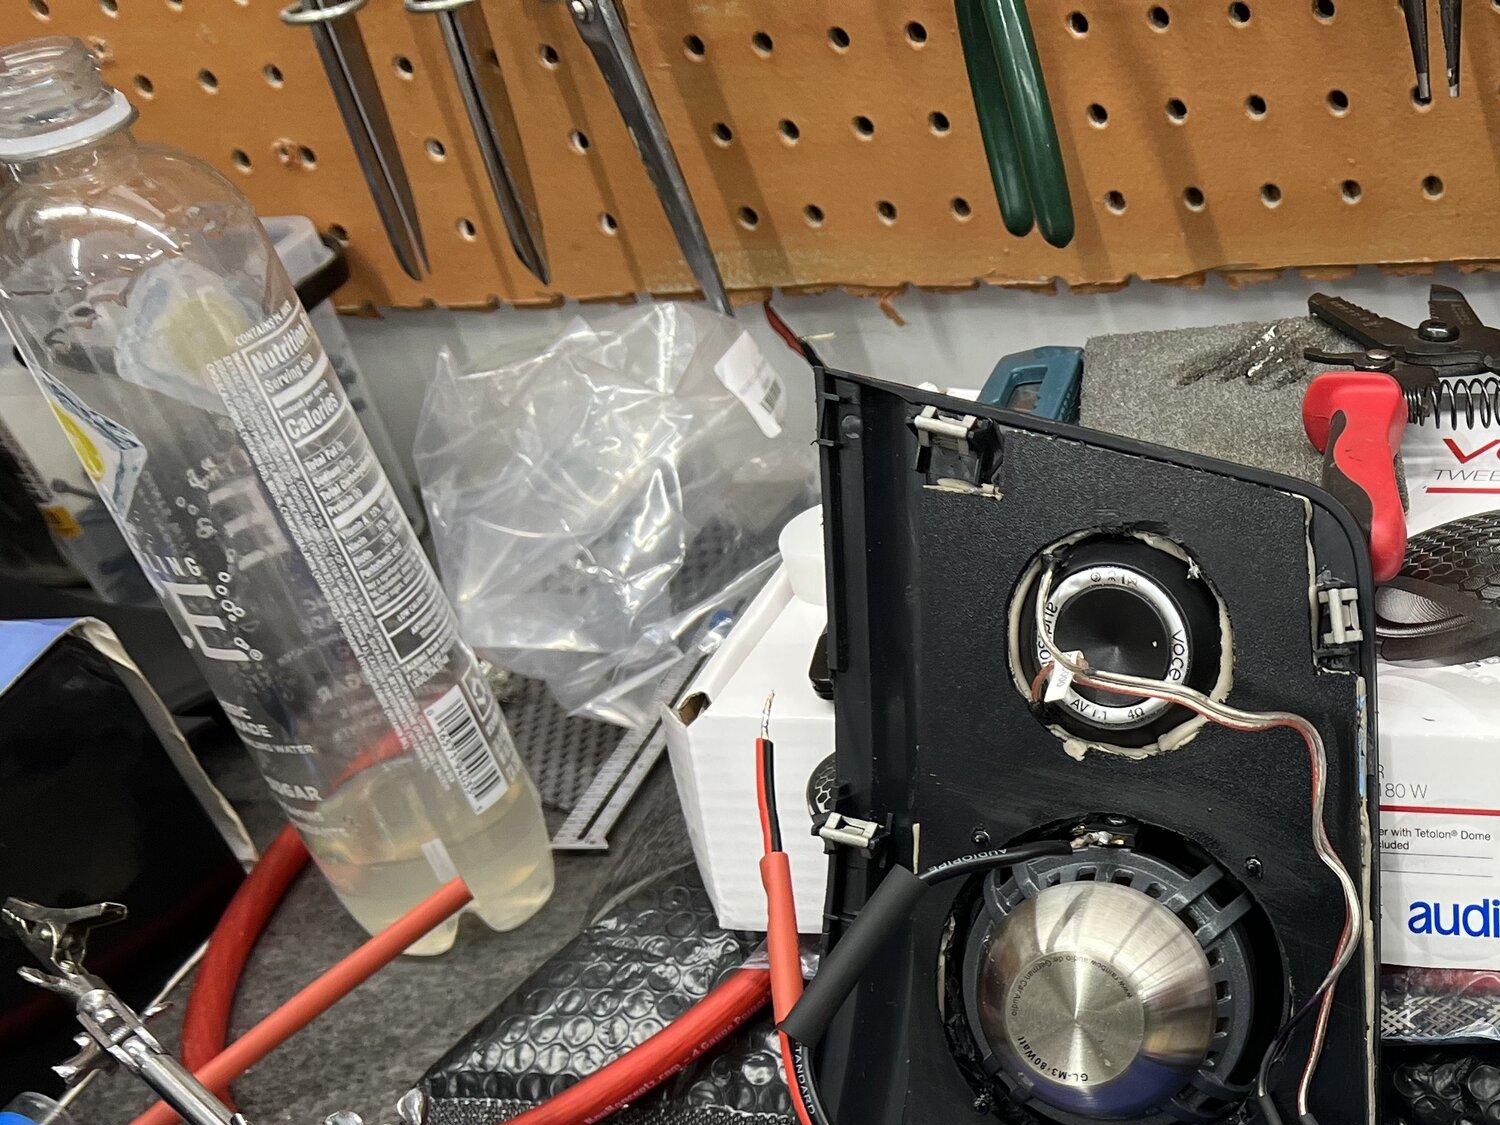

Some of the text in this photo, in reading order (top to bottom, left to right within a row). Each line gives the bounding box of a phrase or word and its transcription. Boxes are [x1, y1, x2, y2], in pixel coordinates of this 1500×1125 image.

[250, 324, 310, 375] Nutrition
[264, 364, 300, 394] Serving
[284, 392, 339, 440] Calories
[1070, 698, 1089, 712] AV
[1410, 784, 1428, 799] W
[1391, 827, 1412, 838] with
[1461, 830, 1491, 841] Dome
[928, 848, 1007, 873] AUDIOPIPE
[794, 1042, 816, 1115] TANDARD
